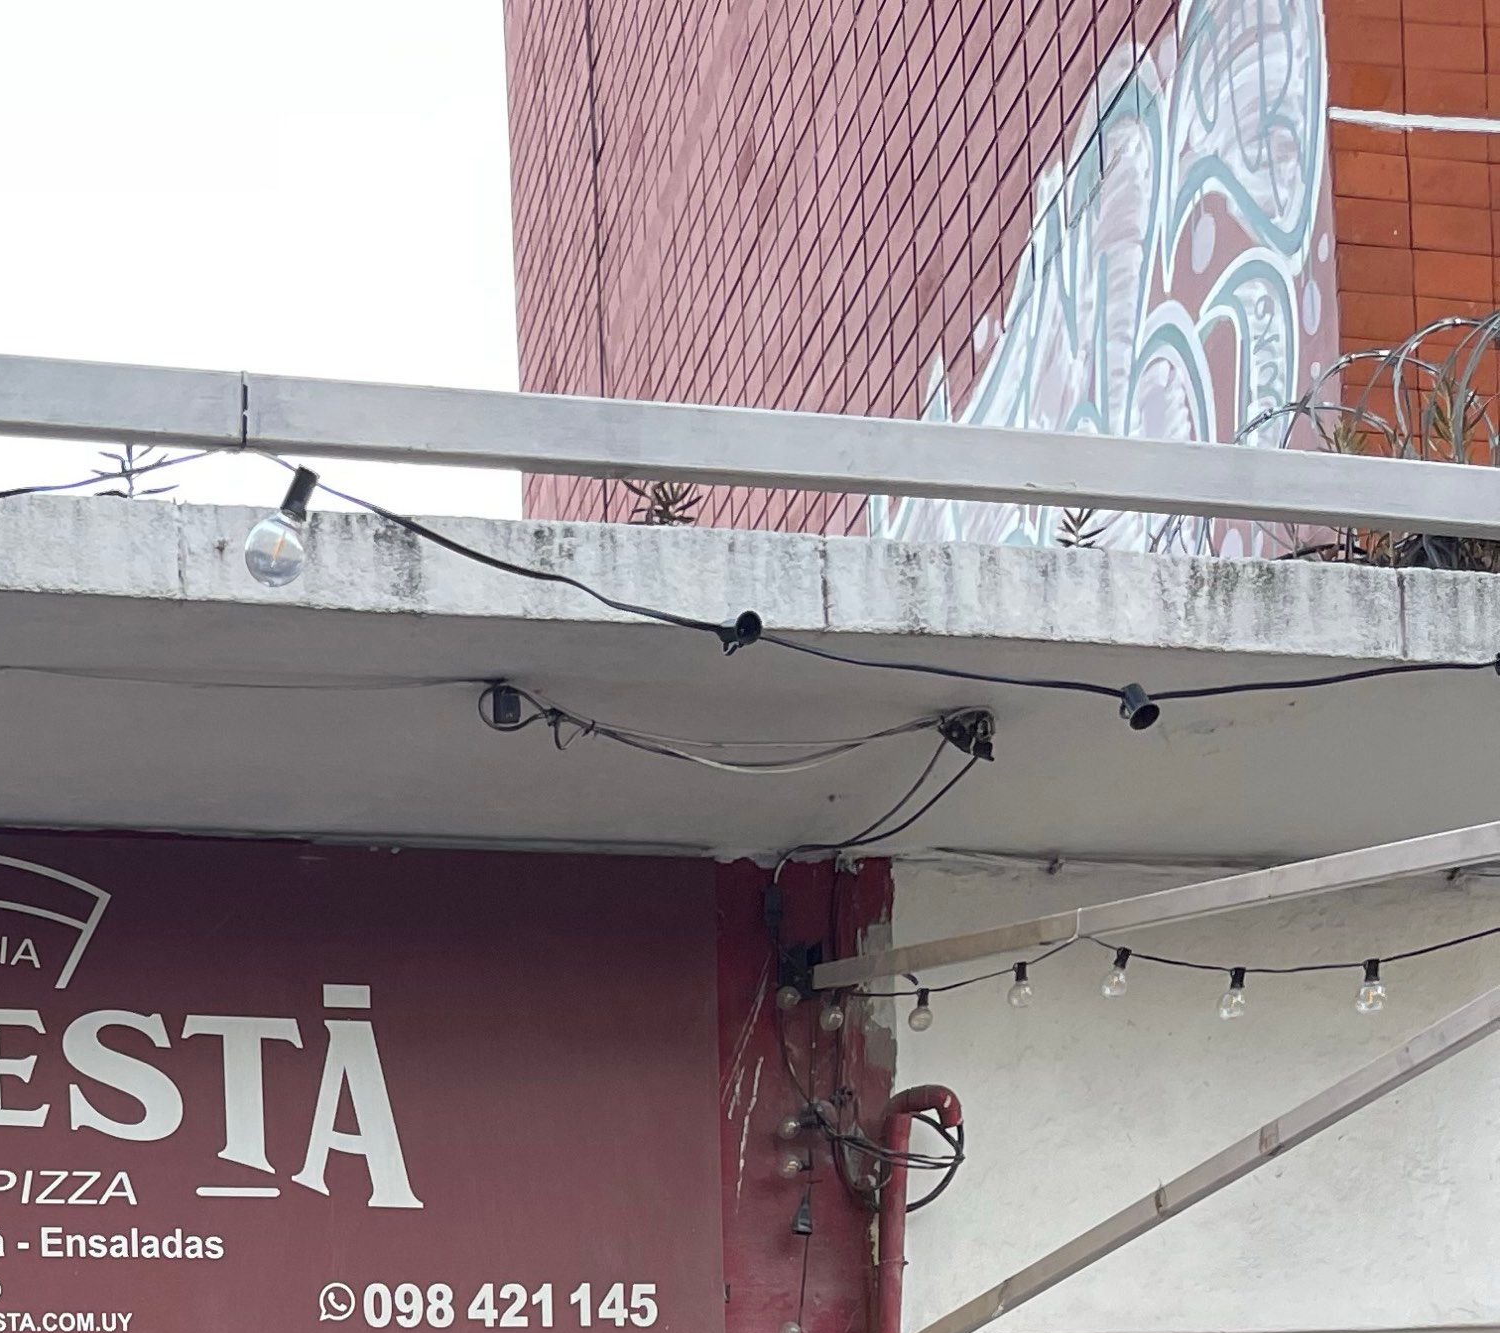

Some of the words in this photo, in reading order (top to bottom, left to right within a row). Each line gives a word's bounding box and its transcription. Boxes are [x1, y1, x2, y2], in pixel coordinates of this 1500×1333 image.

[40, 1226, 224, 1259] Ensaladas
[363, 1282, 455, 1328] 098
[467, 1283, 553, 1328] 421
[570, 1282, 658, 1328] 145
